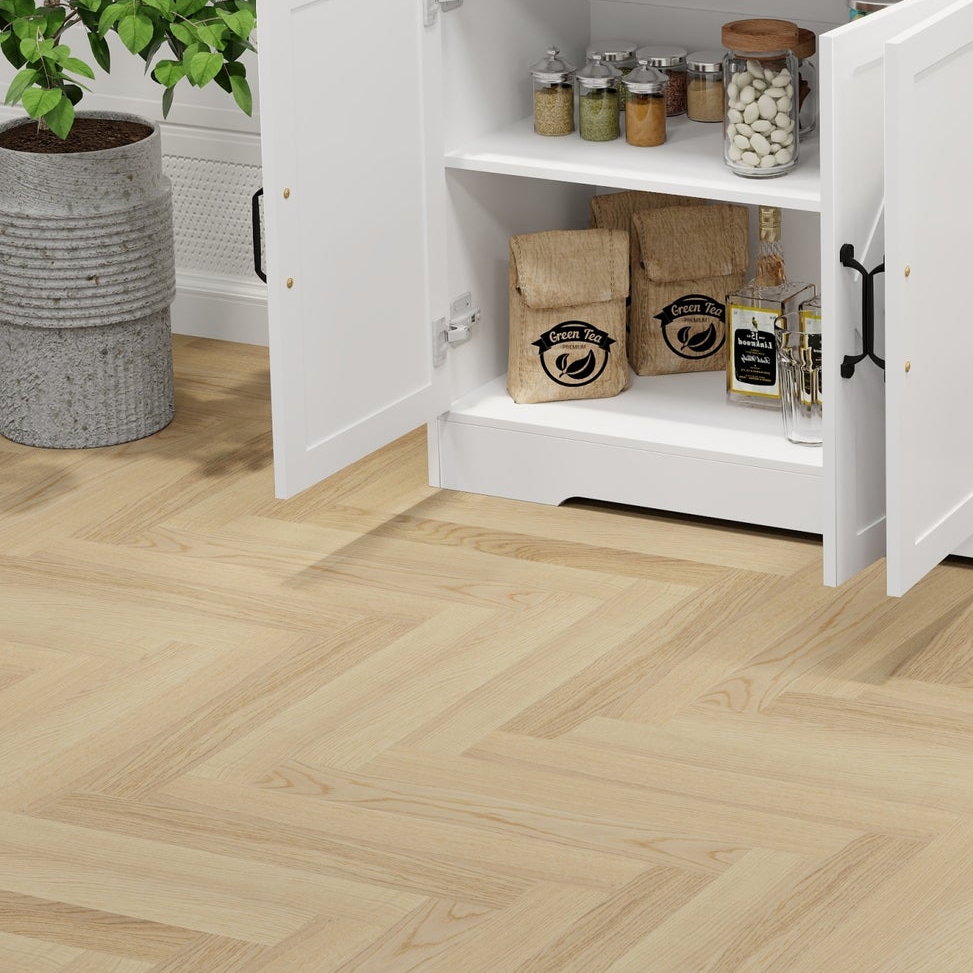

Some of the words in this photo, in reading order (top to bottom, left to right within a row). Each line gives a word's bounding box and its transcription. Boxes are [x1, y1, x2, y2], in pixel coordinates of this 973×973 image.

[671, 304, 701, 316] Green
[704, 302, 723, 316] Tea
[549, 330, 580, 343] Green
[584, 328, 602, 343] Tea
